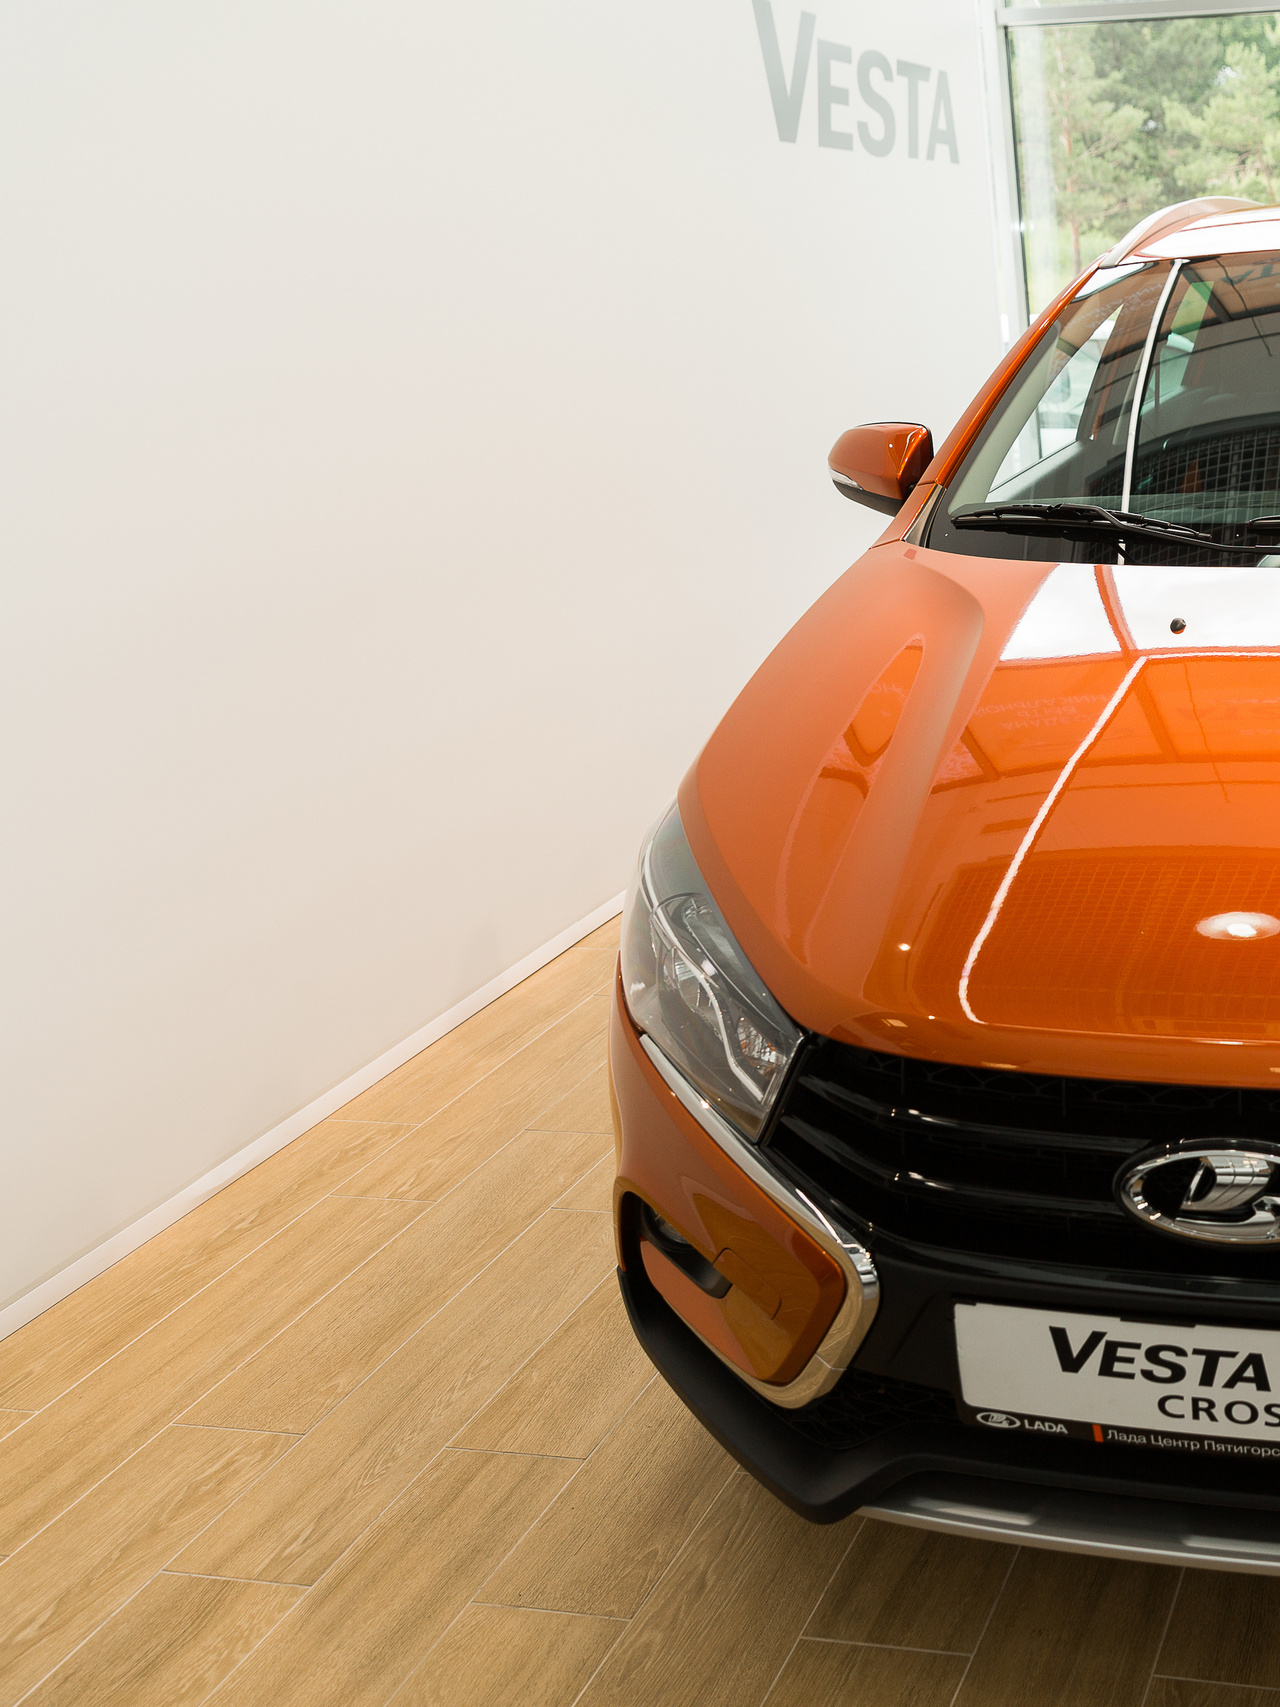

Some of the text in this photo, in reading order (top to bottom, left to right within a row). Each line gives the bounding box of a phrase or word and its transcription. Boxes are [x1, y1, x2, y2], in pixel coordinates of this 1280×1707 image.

[752, 0, 960, 165] VESTA
[1049, 1325, 1271, 1392] VESTA
[1024, 1418, 1068, 1435] LADA
[1107, 1429, 1147, 1445] Лада
[1151, 1434, 1201, 1451] Центр
